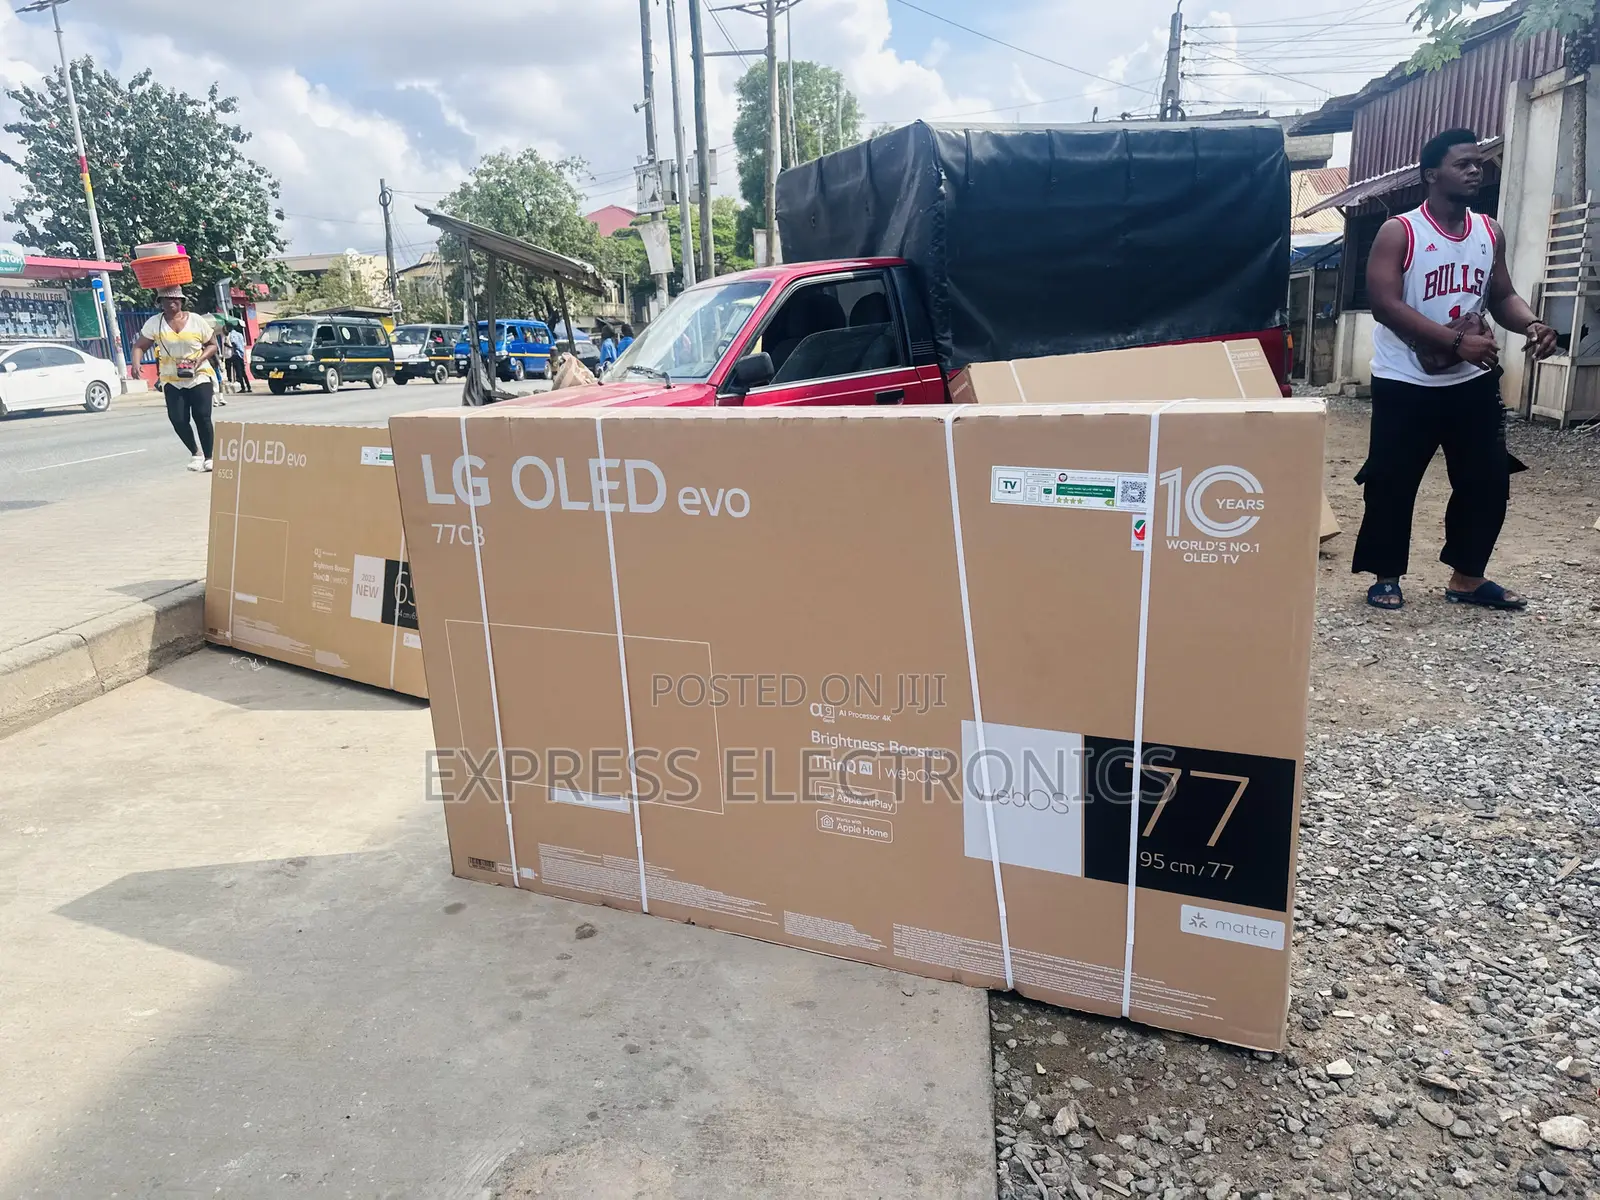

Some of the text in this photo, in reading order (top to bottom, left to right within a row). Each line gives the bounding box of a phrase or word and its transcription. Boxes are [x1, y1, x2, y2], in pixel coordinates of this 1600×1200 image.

[1423, 263, 1485, 301] BULLS
[33, 292, 63, 301] COLLEGE
[219, 438, 307, 467] LG OLED evo
[217, 469, 233, 479] 65C3
[421, 454, 750, 518] LG OLED evo
[1003, 480, 1017, 489] TV
[1216, 499, 1265, 510] YEARS
[431, 524, 485, 546] 77C3
[1166, 540, 1260, 553] WORLD'S NO.1
[1183, 552, 1239, 564] OLED TV
[361, 573, 376, 583] 2023
[355, 583, 379, 598] NEW
[839, 709, 892, 722] AI Processor 4K
[811, 730, 947, 760] Brightness Booster
[813, 755, 941, 785] ThinQ AI webOS
[837, 795, 893, 811] Apple AirPlay
[1125, 762, 1249, 847] 77
[837, 823, 889, 838] Apple Home
[1215, 919, 1277, 940] matter
